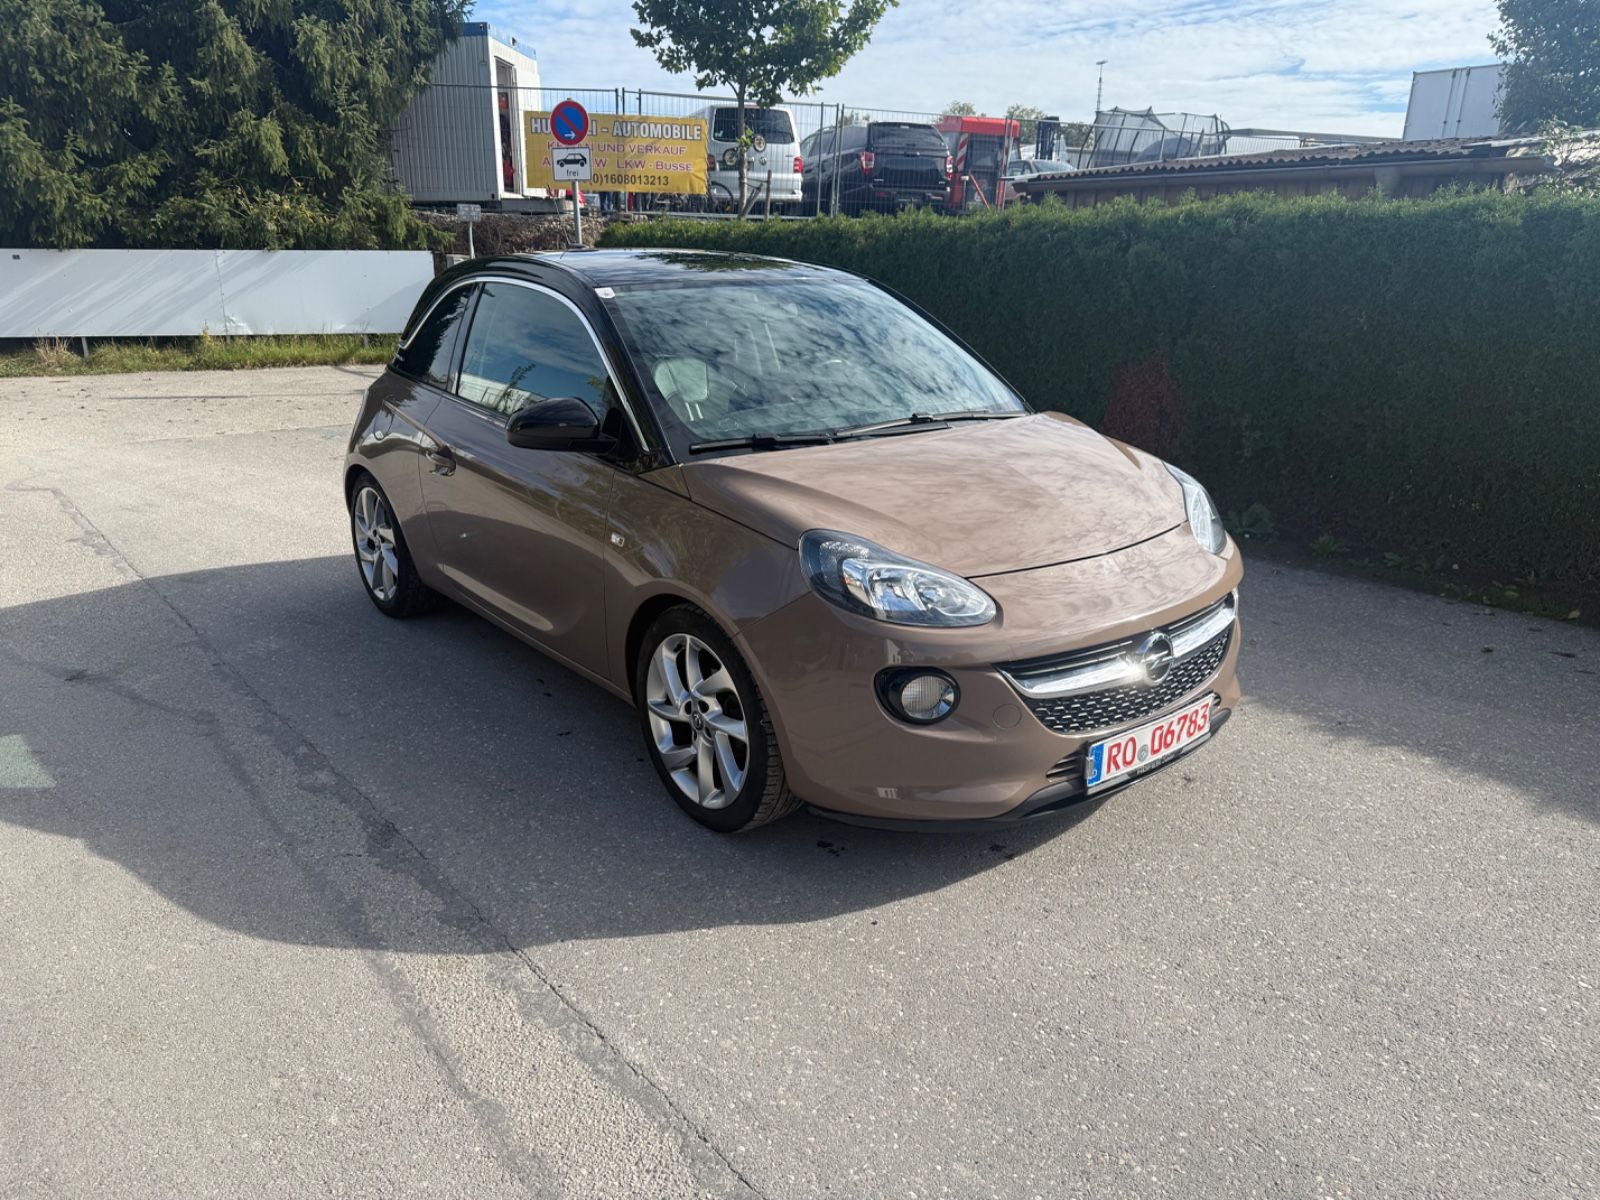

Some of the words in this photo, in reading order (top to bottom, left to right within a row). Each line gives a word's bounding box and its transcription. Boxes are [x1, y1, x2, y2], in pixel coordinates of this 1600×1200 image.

[612, 120, 702, 140] AUTOMOBILE
[598, 143, 625, 153] UND
[629, 143, 687, 156] VERKAUF
[616, 160, 646, 171] LKW
[566, 168, 579, 177] frei
[1106, 736, 1137, 774] RO
[1150, 702, 1210, 756] 06783
